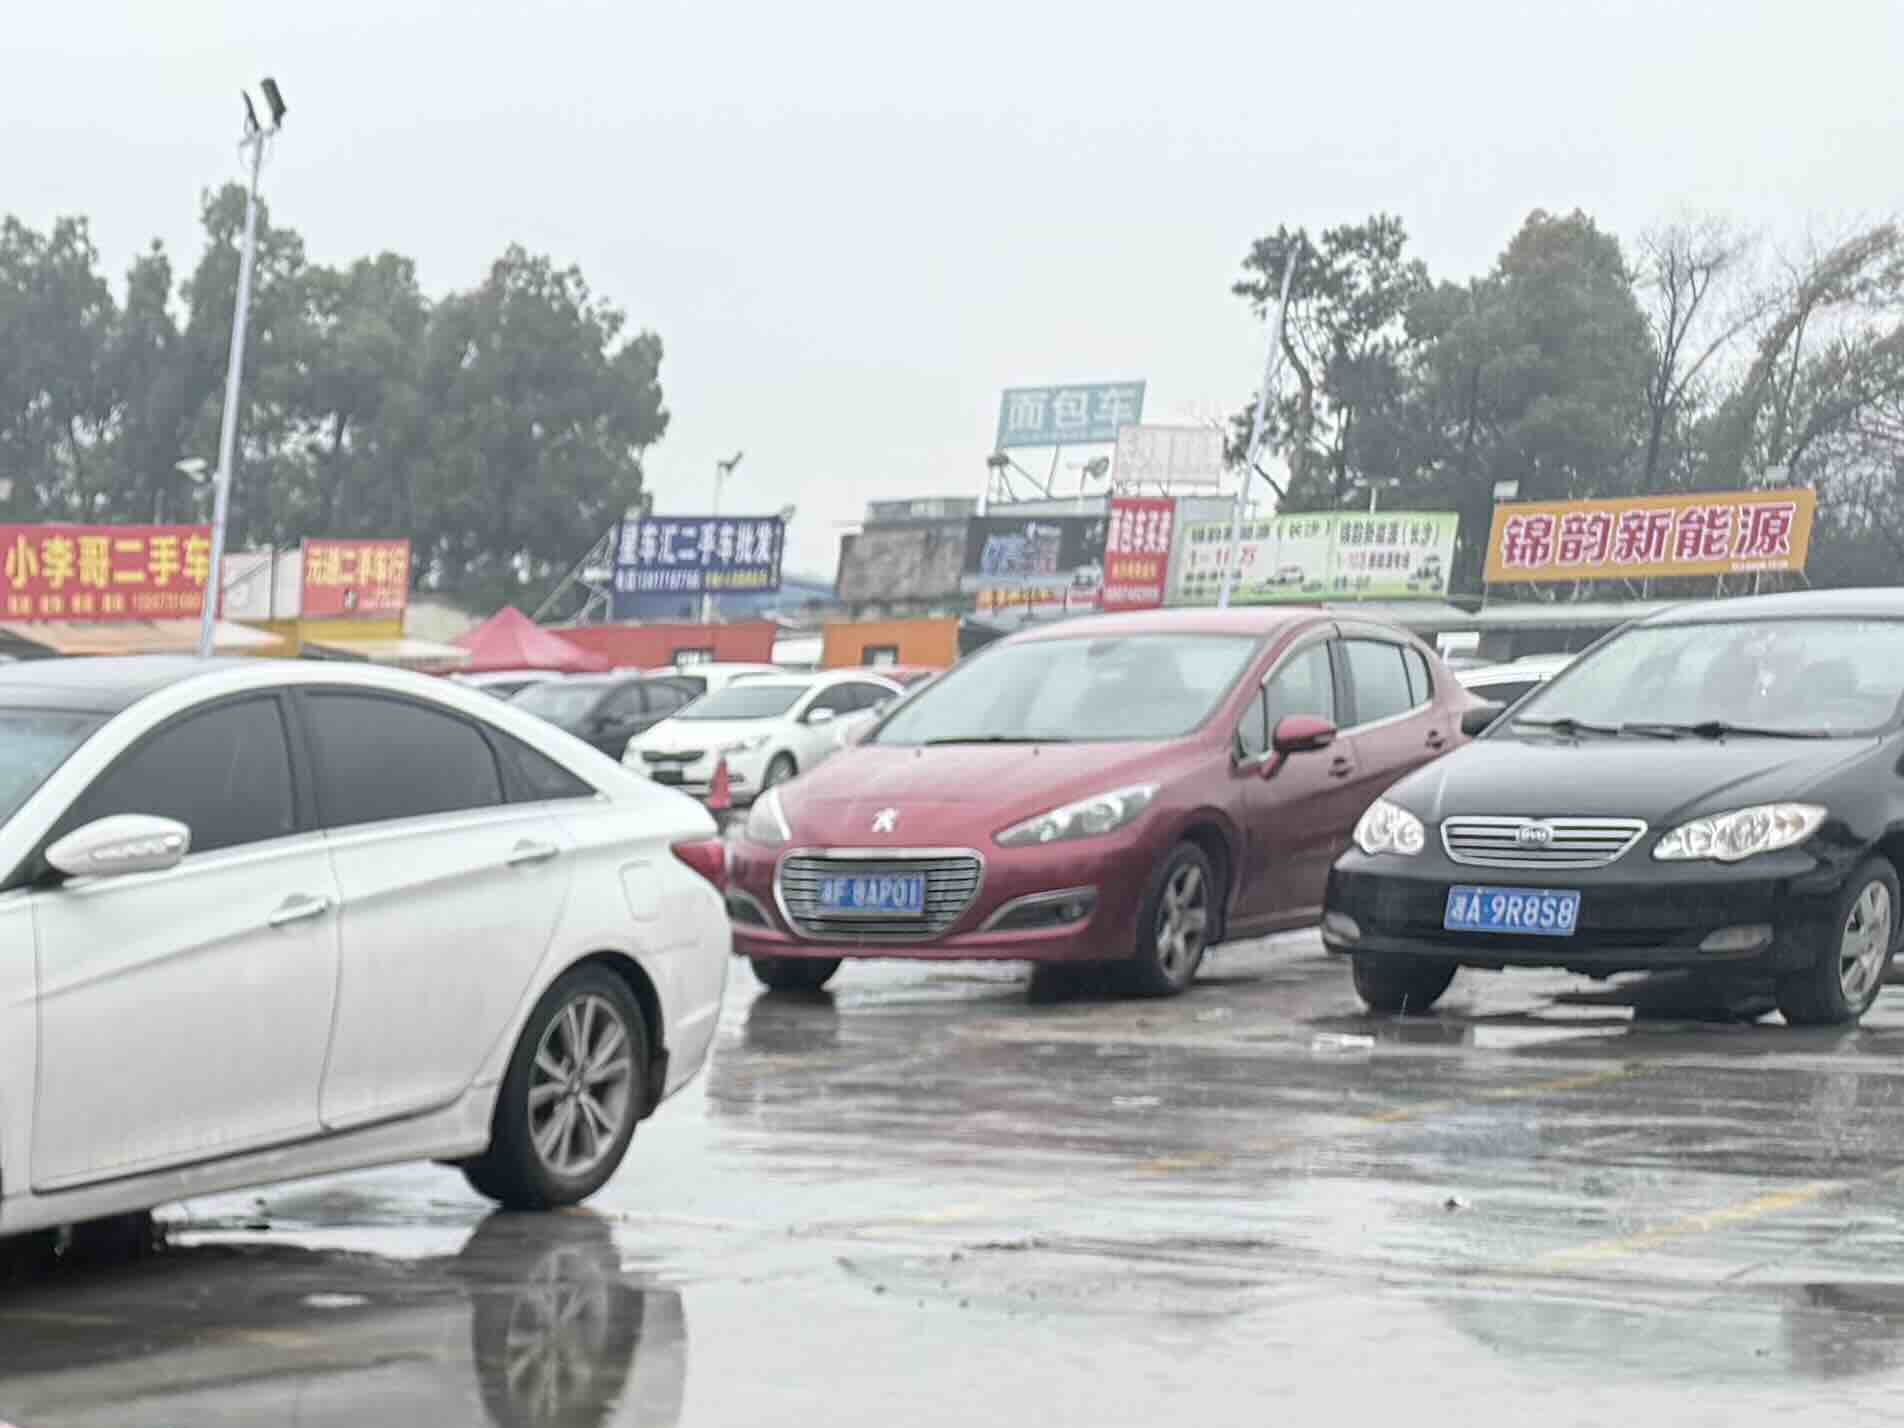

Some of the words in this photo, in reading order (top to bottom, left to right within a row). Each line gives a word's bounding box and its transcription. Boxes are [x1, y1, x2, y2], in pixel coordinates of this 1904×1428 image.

[1008, 387, 1137, 431] 面包车
[5, 532, 211, 588] 小李哥二手车
[1503, 502, 1795, 568] 锦韵新能源
